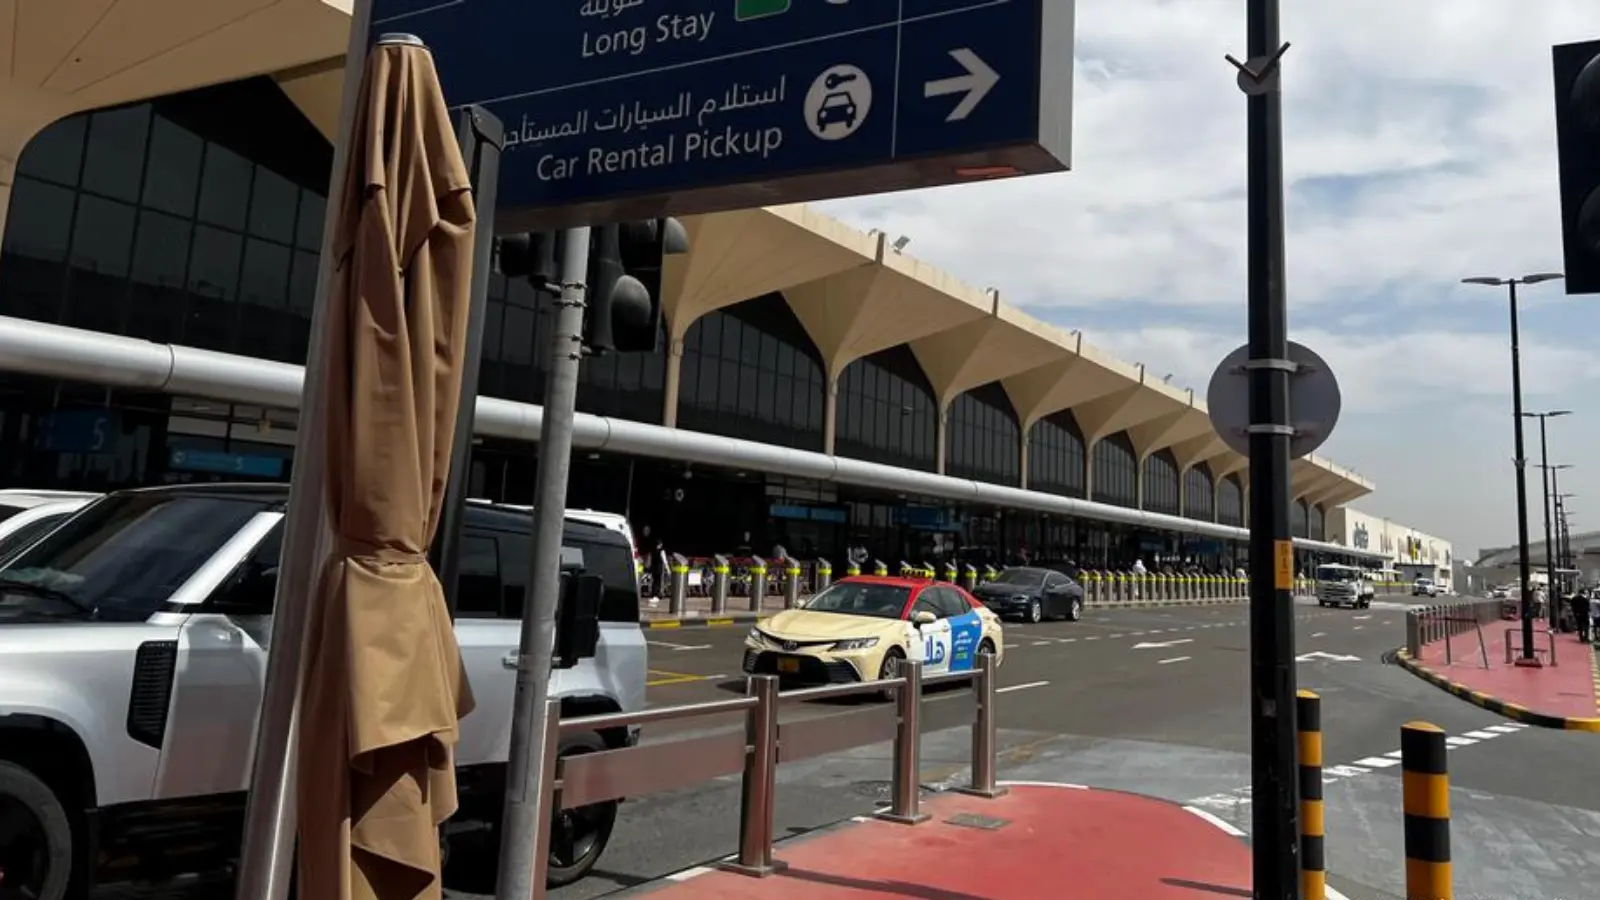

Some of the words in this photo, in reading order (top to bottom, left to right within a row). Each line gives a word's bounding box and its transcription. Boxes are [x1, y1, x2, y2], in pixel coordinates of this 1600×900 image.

[582, 26, 647, 58] Long
[656, 11, 715, 42] Stay
[594, 91, 692, 133] السيارات
[697, 75, 786, 125] استلام
[501, 109, 588, 152] المستأجر
[537, 154, 577, 181] Car
[587, 134, 674, 175] Rental
[684, 124, 784, 160] Pickup
[90, 417, 108, 450] 5
